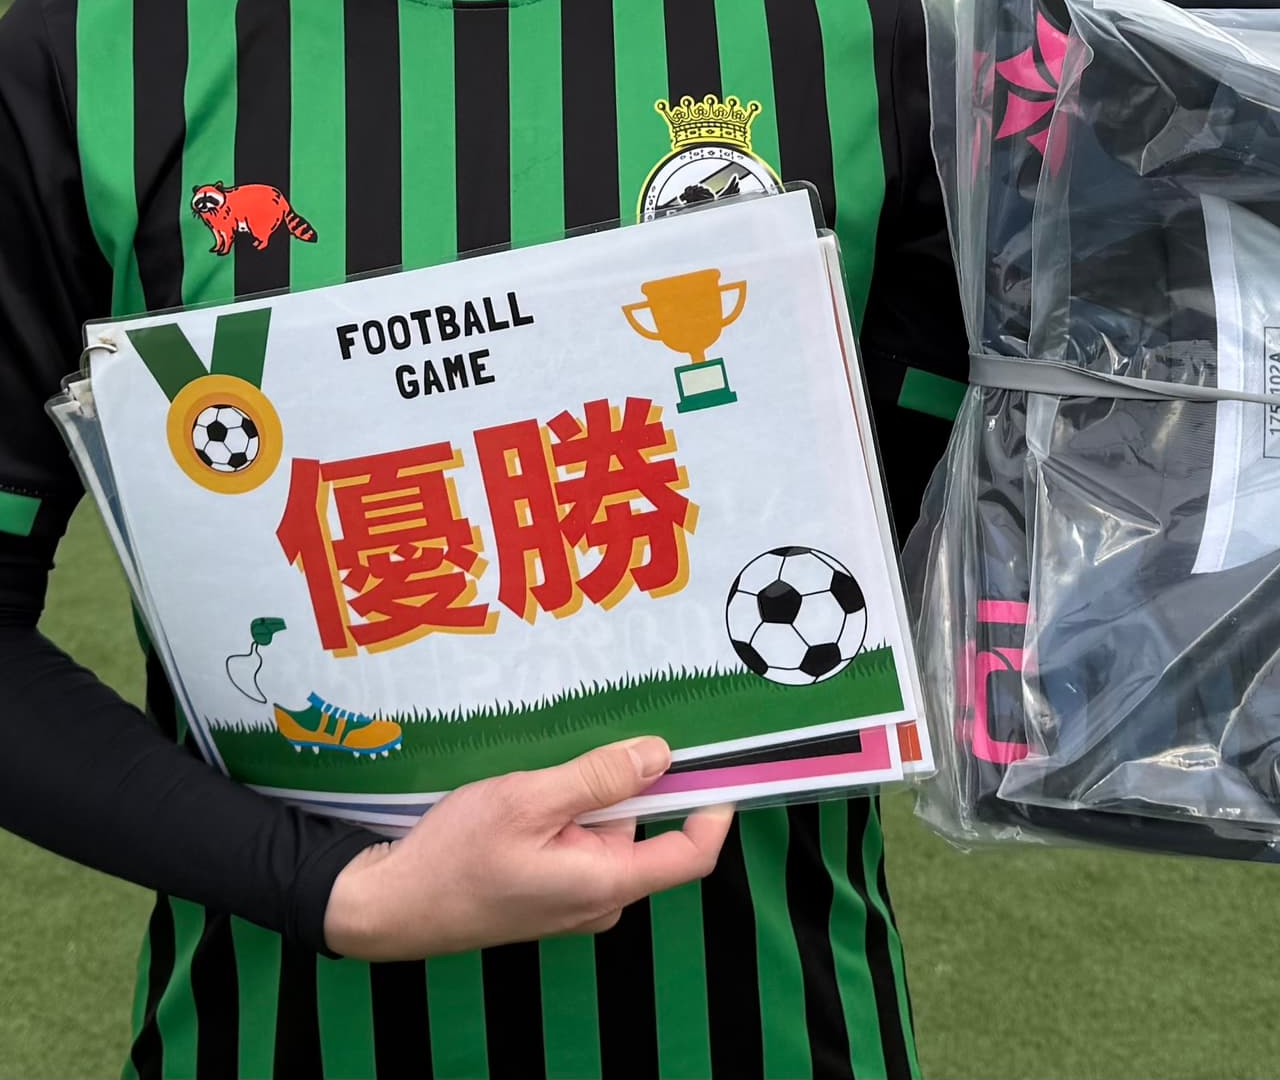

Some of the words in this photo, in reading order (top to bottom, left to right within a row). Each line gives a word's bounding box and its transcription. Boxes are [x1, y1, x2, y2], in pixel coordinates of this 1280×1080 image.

[336, 291, 534, 360] FOOTBALL
[395, 349, 495, 399] GAME
[276, 397, 700, 658] 優勝
